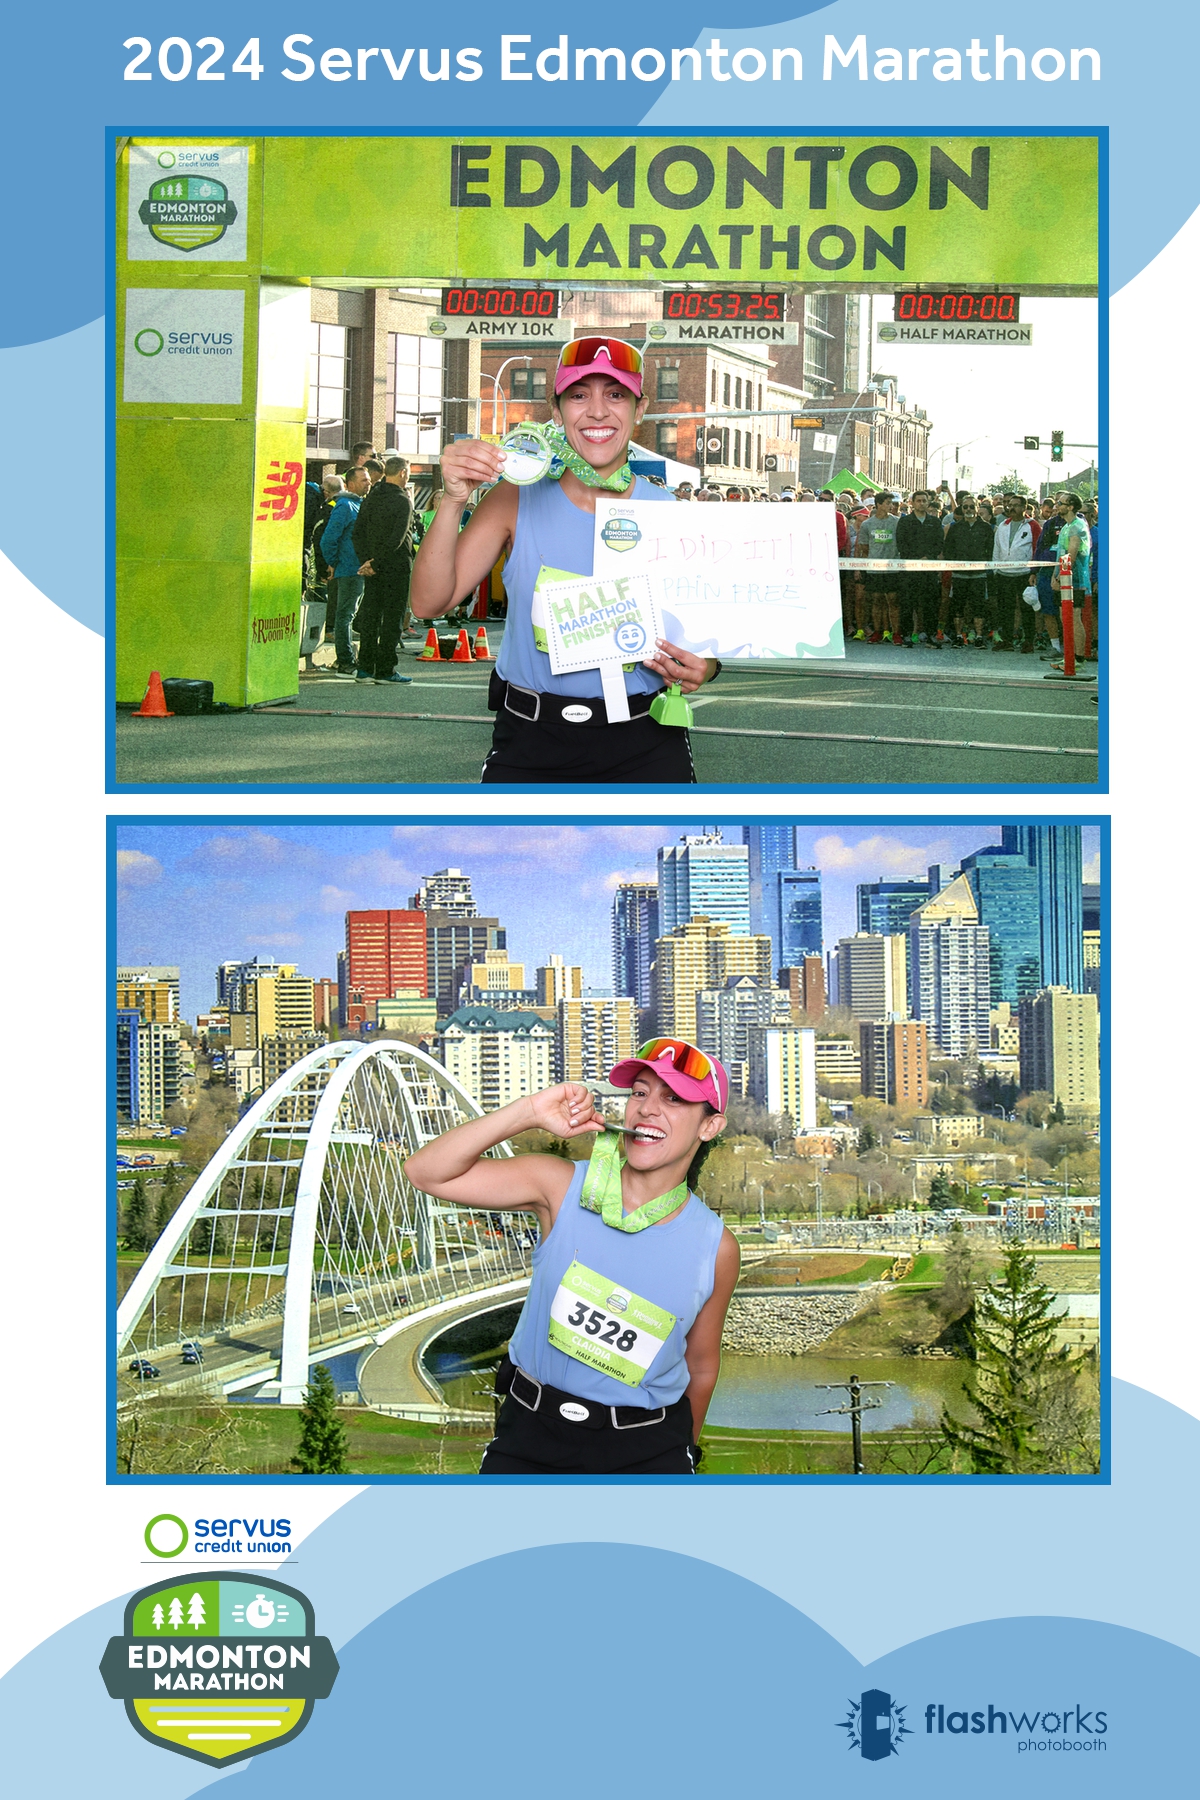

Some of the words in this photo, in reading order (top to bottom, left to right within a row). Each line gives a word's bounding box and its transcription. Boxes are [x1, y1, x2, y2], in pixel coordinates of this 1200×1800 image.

[178, 152, 220, 161] servus
[450, 144, 991, 211] EDMONTON
[149, 202, 227, 213] EDMONTON
[160, 214, 215, 222] MARATHON
[522, 223, 907, 271] MARATHON
[168, 332, 233, 345] servus
[466, 321, 518, 335] ARMY
[521, 322, 554, 336] 10K
[678, 325, 785, 340] MARATHON
[900, 328, 939, 340] HALF
[943, 328, 1030, 341] MARATHON
[167, 345, 200, 355] credit
[202, 347, 233, 355] union
[648, 537, 667, 562] I
[551, 577, 631, 624] HALF
[732, 583, 801, 603] FREE
[257, 613, 291, 637] Running
[558, 598, 638, 635] MARATHON
[561, 609, 643, 649] FINISHER!
[568, 1300, 638, 1352] 3528
[571, 1335, 612, 1362] CLAUDIA
[575, 1349, 592, 1365] HALF
[592, 1358, 627, 1380] MARATHON
